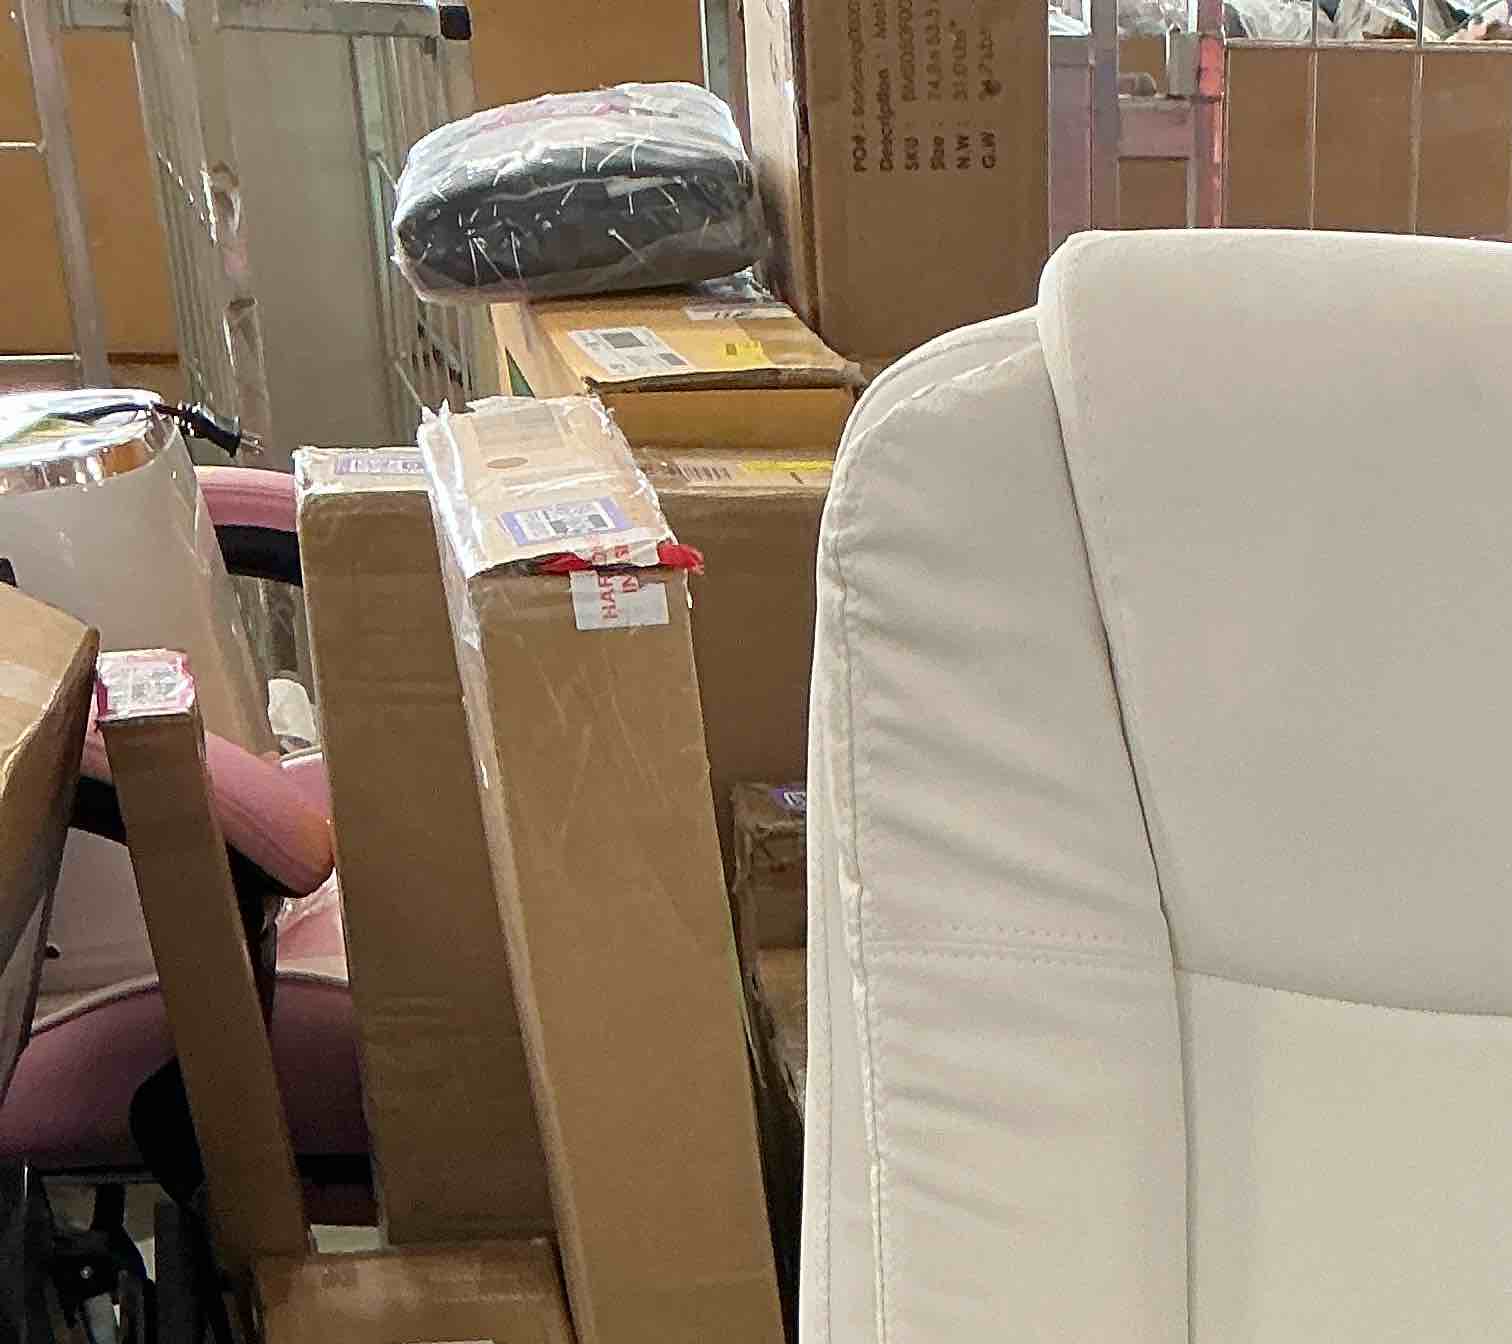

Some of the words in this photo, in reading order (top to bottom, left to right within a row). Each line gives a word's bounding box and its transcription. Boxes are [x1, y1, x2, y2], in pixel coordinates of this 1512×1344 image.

[876, 67, 894, 173] Description
[903, 136, 920, 172] SKU
[929, 136, 947, 172] Size
